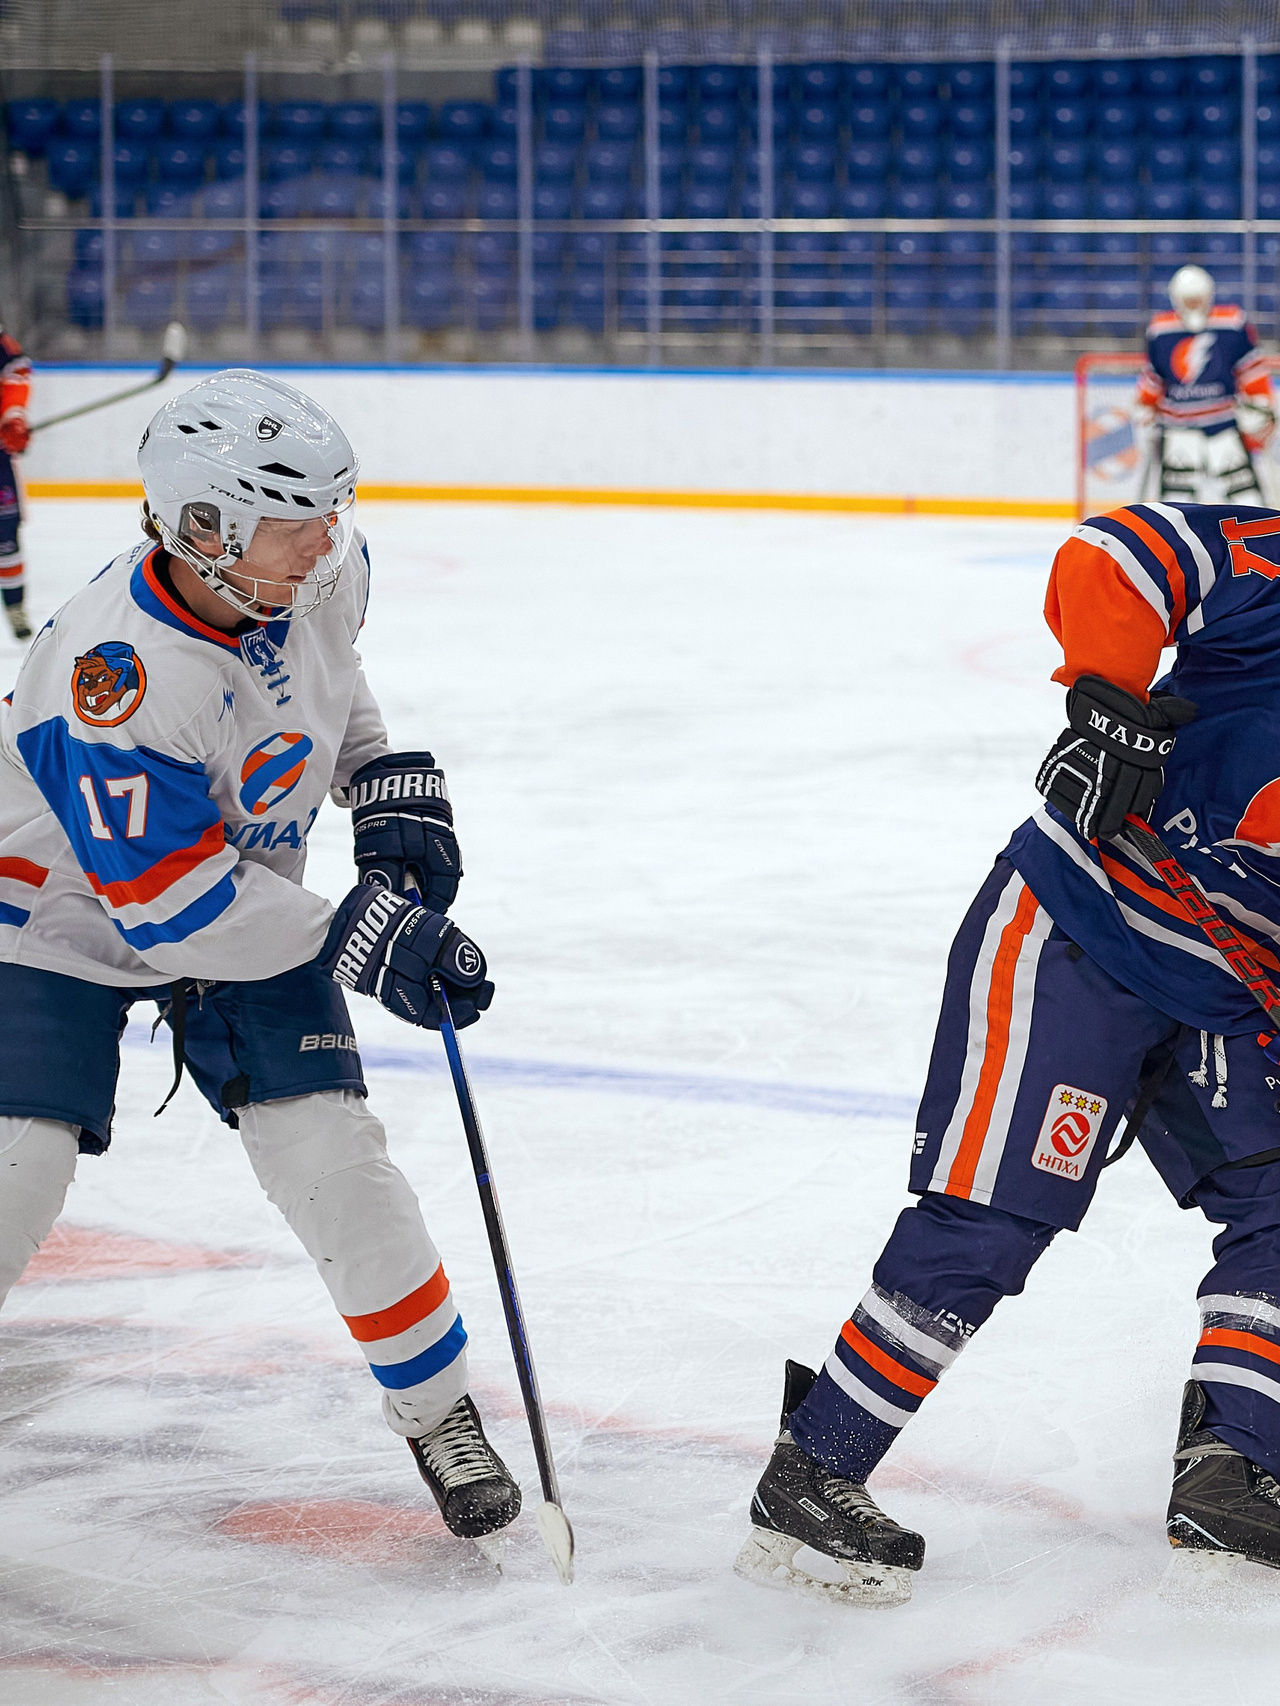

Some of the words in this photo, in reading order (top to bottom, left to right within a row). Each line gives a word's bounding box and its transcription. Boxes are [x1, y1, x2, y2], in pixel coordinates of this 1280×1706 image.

[263, 418, 280, 431] SHL
[207, 482, 255, 506] TRUE
[78, 772, 149, 840] 17
[332, 890, 405, 990] ARRIOR
[1038, 1152, 1079, 1177] НПХЛ
